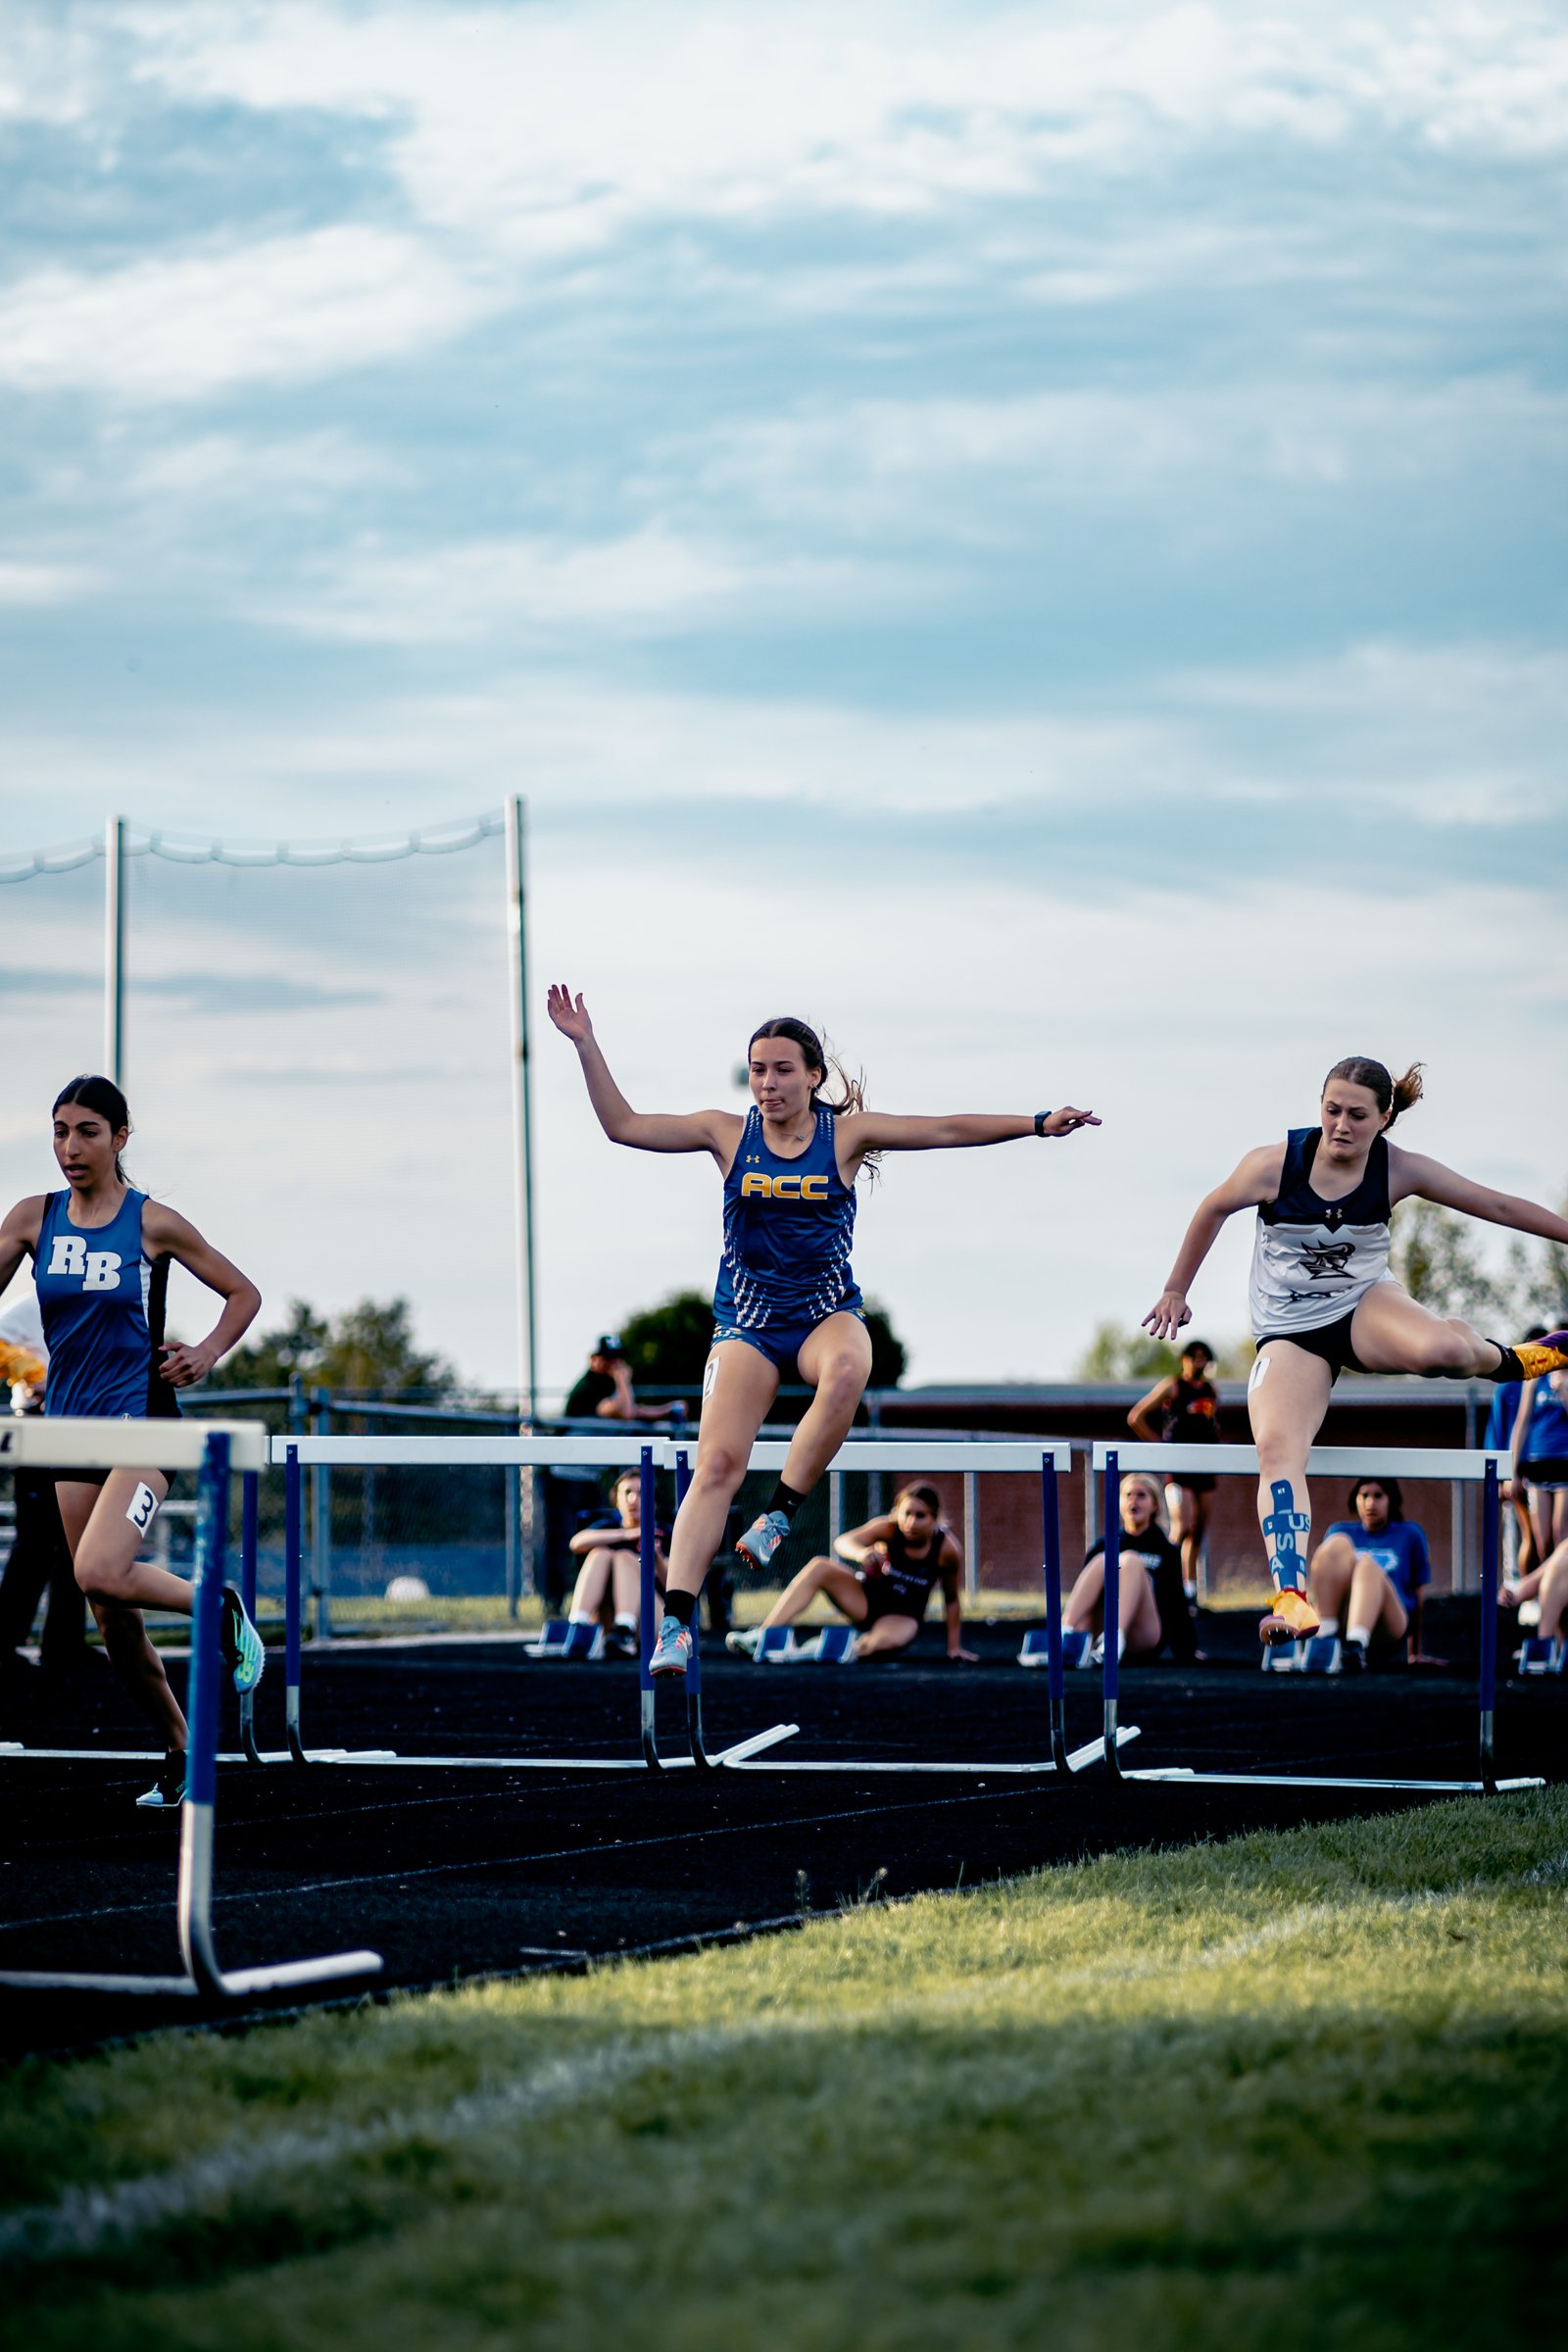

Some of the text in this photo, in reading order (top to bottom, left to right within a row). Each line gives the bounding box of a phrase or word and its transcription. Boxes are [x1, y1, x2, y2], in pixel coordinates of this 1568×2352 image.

[741, 1172, 829, 1200] ACC
[47, 1236, 122, 1291] RB
[133, 1490, 153, 1528] 3
